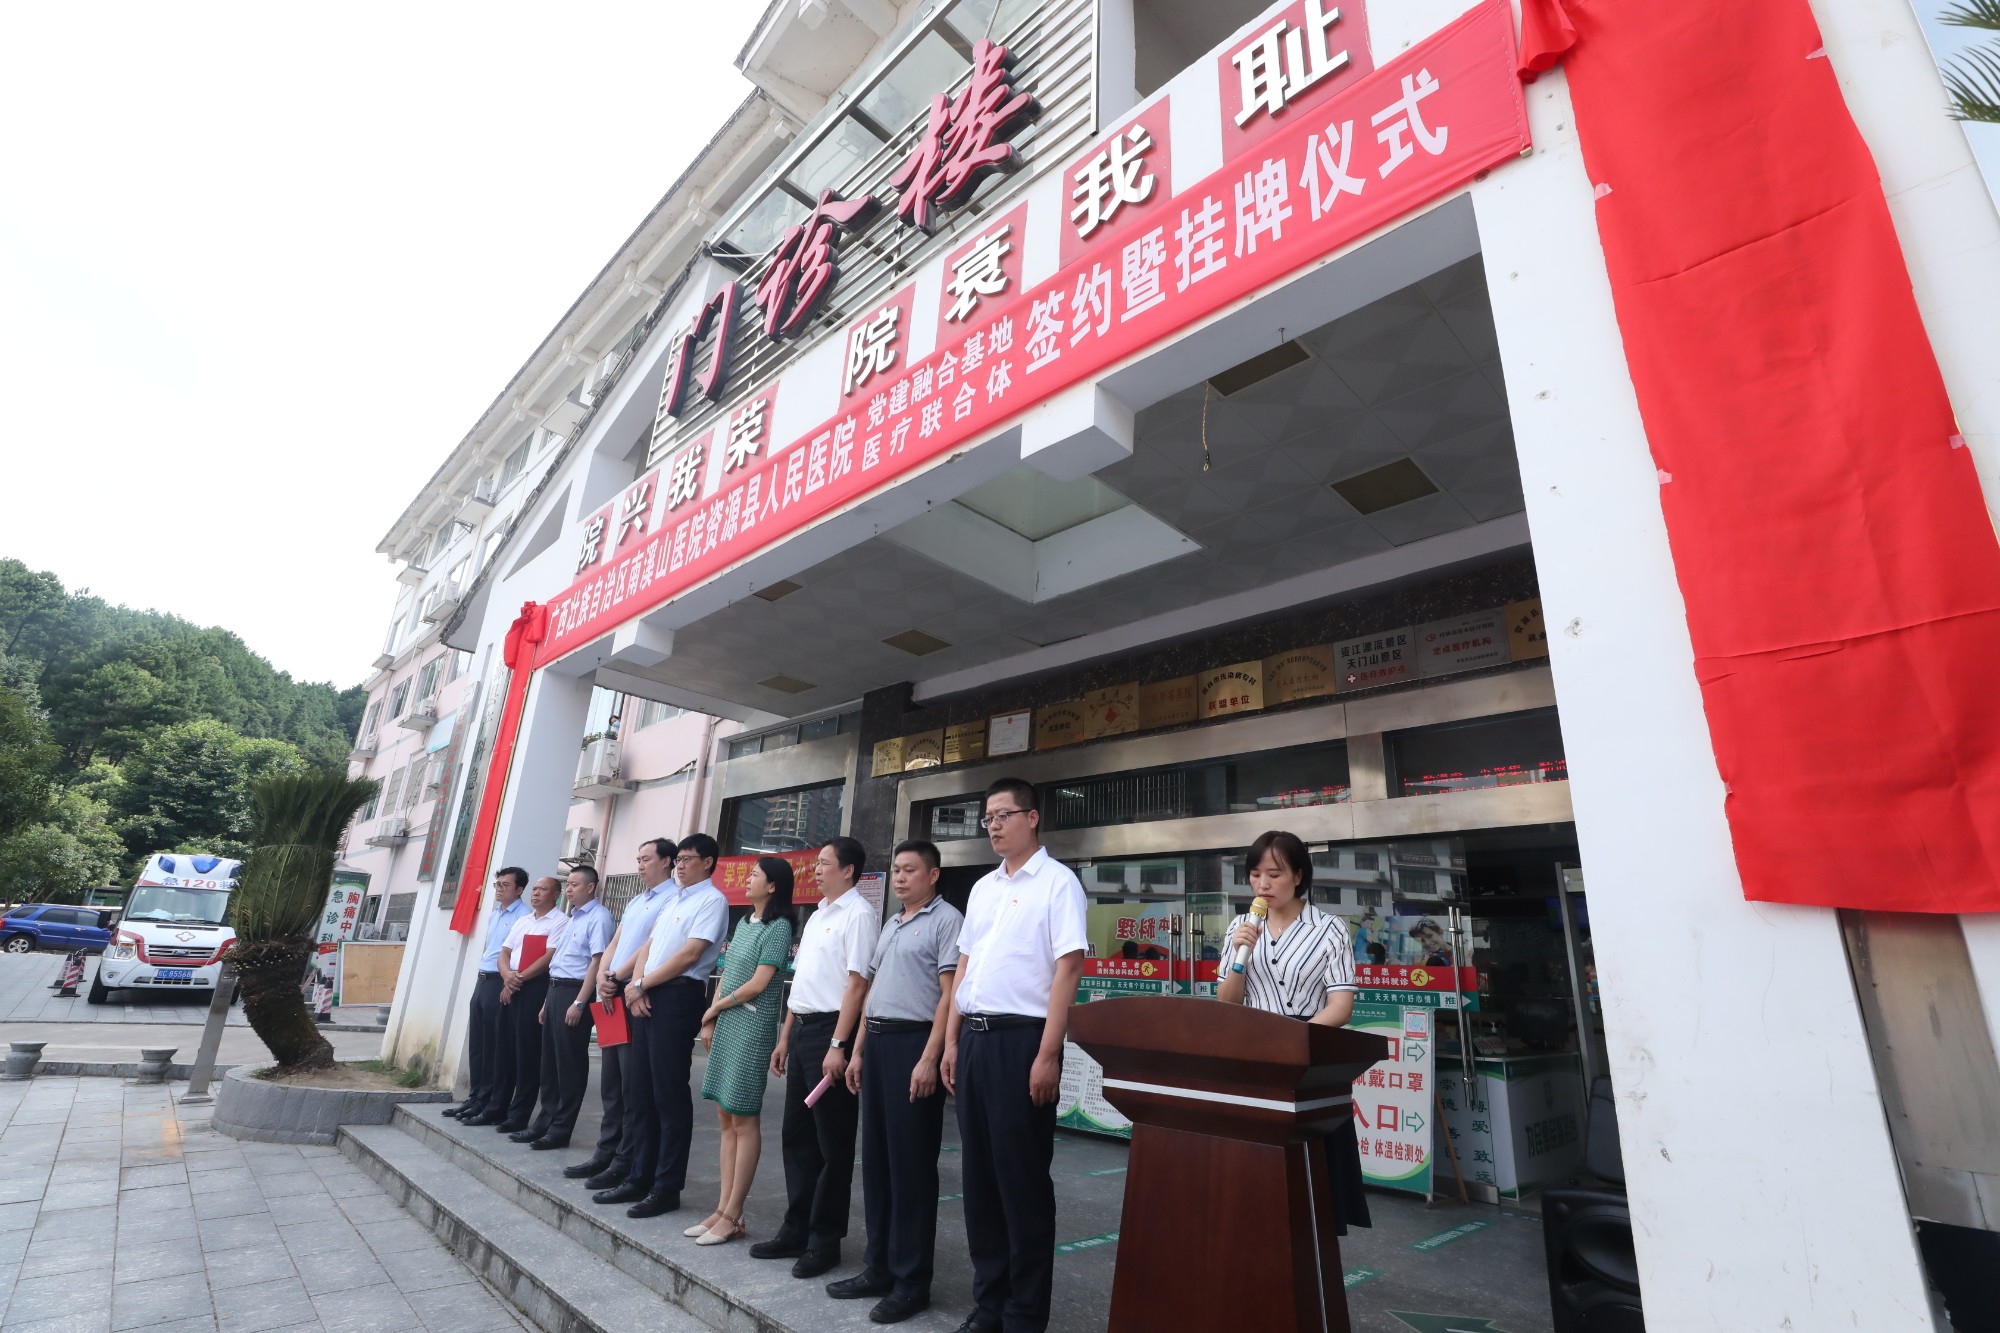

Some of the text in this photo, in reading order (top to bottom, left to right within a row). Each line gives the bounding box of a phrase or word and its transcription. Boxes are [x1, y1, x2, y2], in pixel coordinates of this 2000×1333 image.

[666, 39, 1042, 418] 门诊楼
[1024, 67, 1449, 374] 签约暨挂牌仪式
[575, 0, 1351, 575] 院兴我荣 院衰我耻
[861, 363, 1012, 472] 医疗联合体
[866, 315, 1013, 432] 党建融合基地
[544, 414, 857, 647] 广西壮族自治区南溪山医院资源县人民医院
[1209, 695, 1250, 710] 联盟单位
[1347, 649, 1402, 669] 天门山景区
[723, 860, 757, 889] 学党
[1375, 1139, 1425, 1164] 体温检测处
